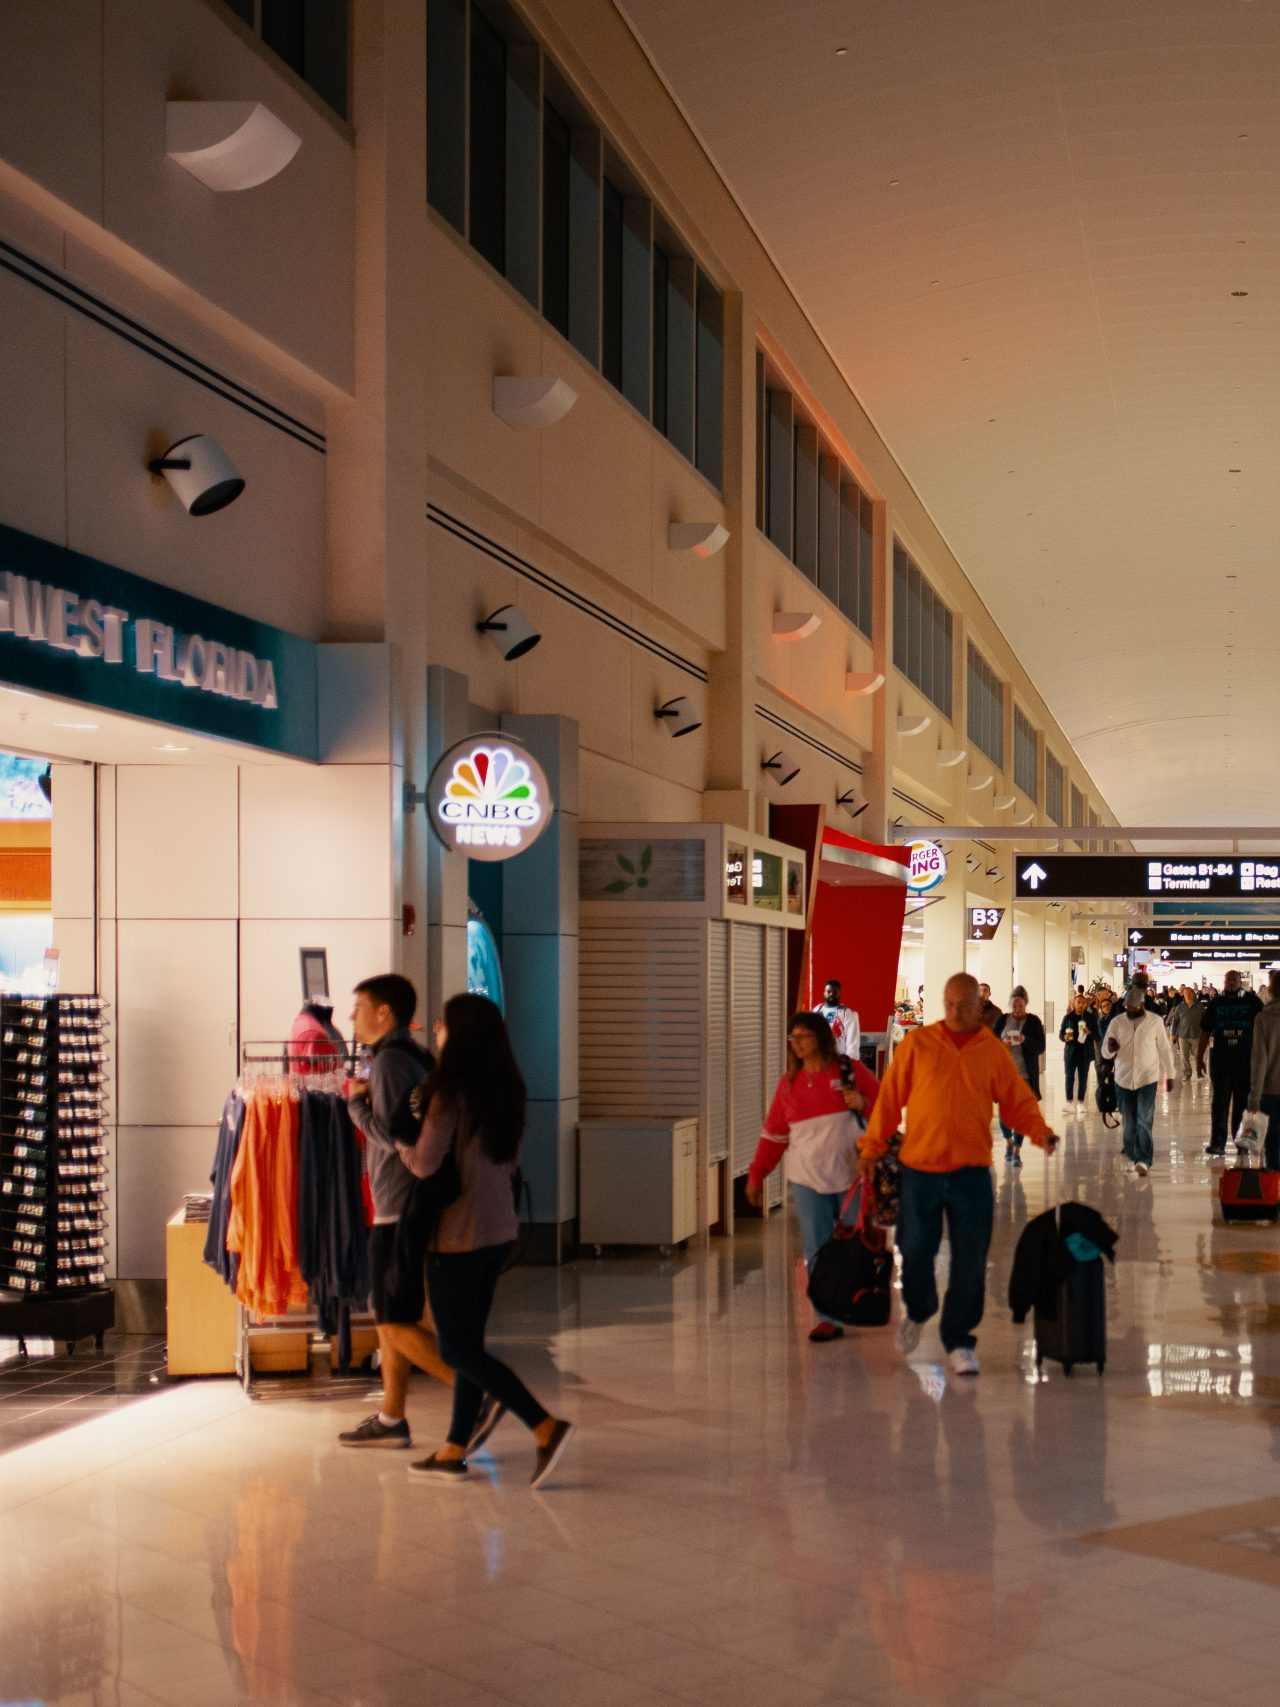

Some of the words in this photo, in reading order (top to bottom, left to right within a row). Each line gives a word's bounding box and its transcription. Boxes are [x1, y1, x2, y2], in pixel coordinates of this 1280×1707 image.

[135, 619, 278, 708] FLORIDA
[441, 802, 535, 821] CNBC
[455, 824, 522, 847] NEWS
[912, 848, 938, 861] RGER
[912, 857, 940, 876] ING
[1163, 864, 1197, 876] Gates
[1199, 864, 1234, 876] B1-B4
[1255, 864, 1279, 878] Bag
[1163, 878, 1210, 889] Terminal
[972, 909, 999, 926] B3
[1116, 954, 1127, 962] B1
[1216, 1005, 1250, 1016] SIZE
[1223, 1029, 1244, 1038] BULK
